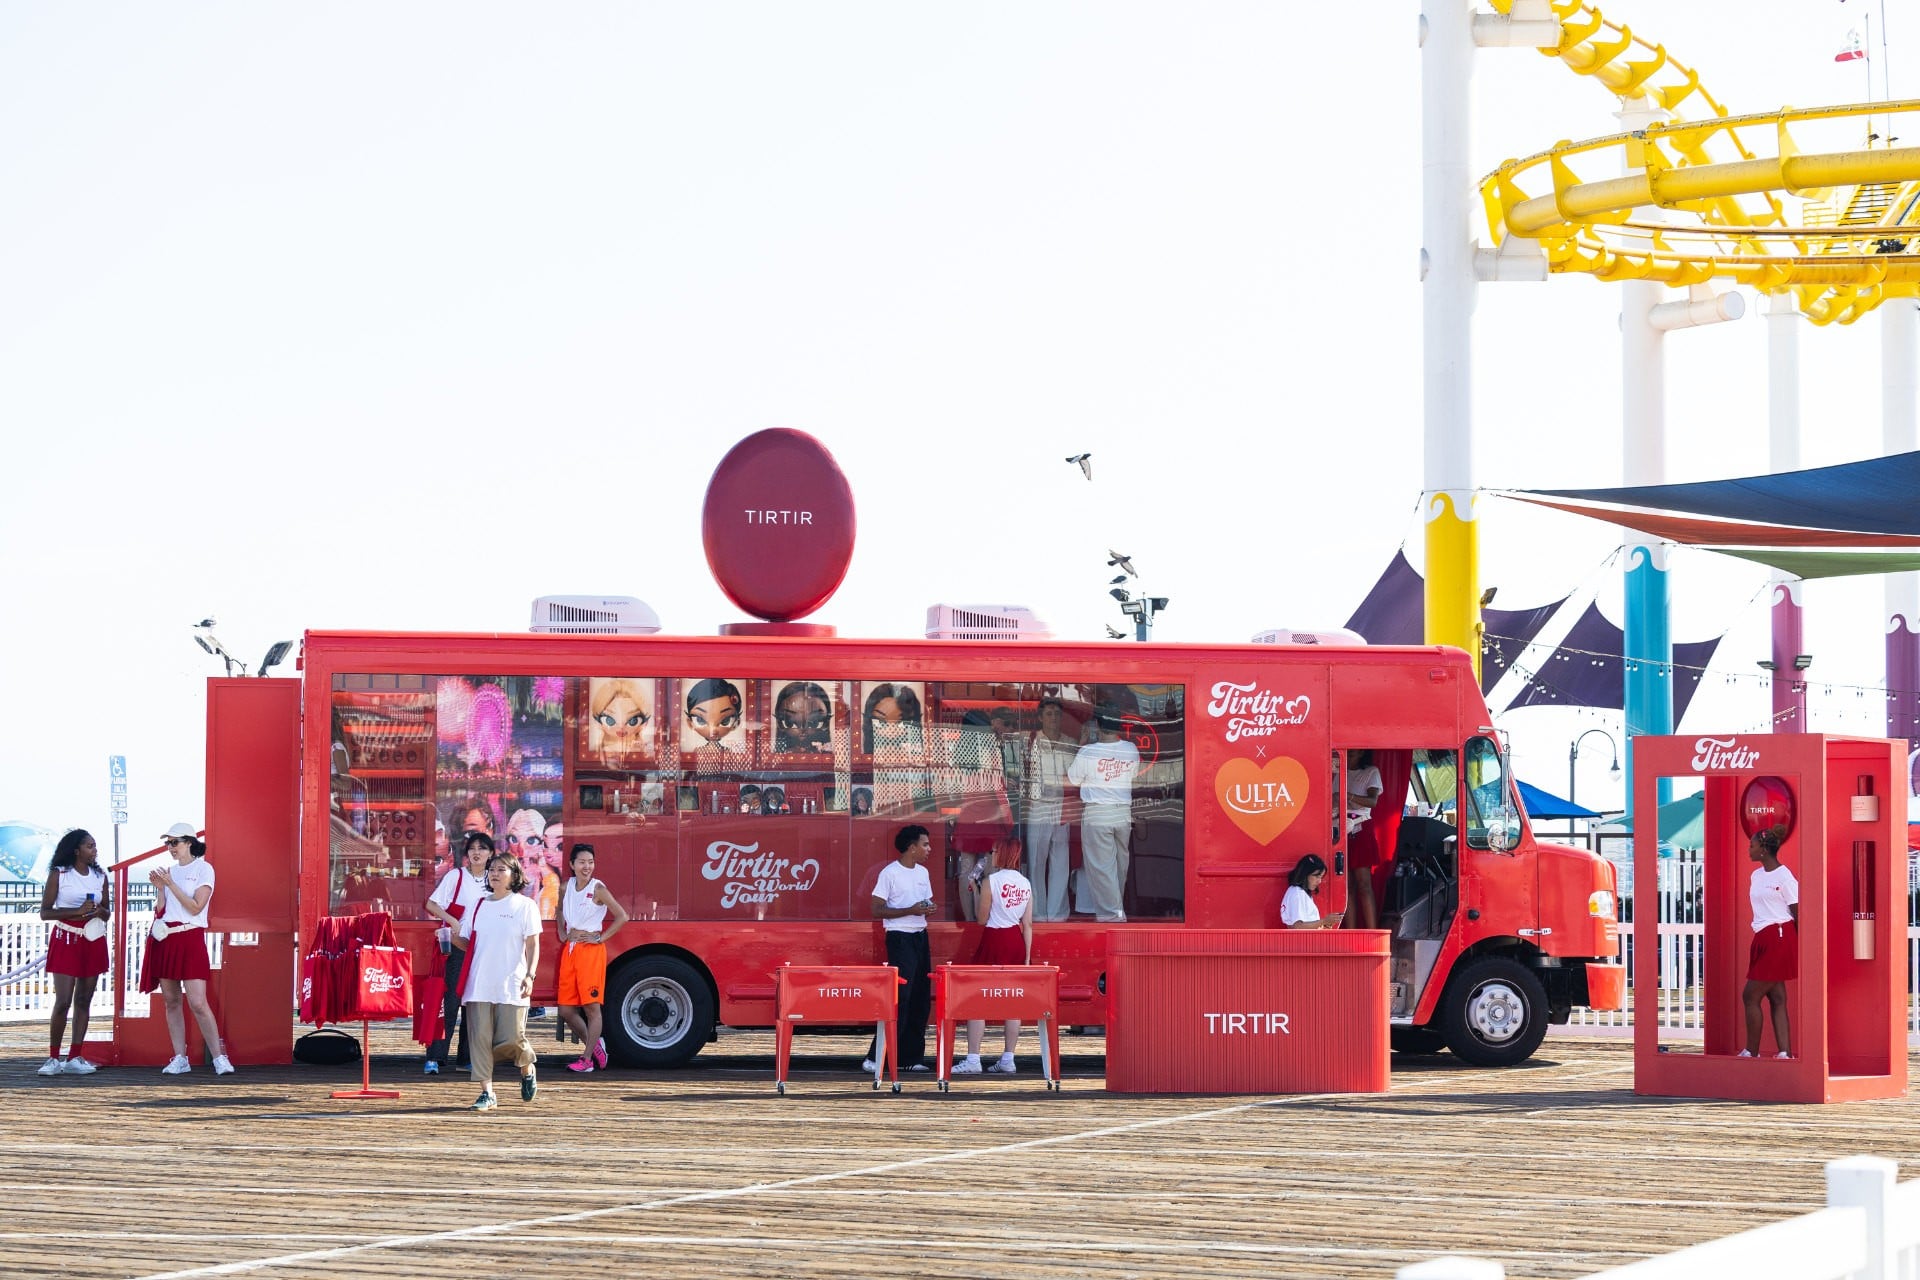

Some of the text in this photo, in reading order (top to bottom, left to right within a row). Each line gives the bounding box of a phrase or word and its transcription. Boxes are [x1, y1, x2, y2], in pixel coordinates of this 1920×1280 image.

[744, 509, 813, 525] TIRTIR
[1207, 680, 1284, 718] Tirtir
[1254, 713, 1303, 727] World
[1225, 717, 1277, 743] Tour
[1691, 737, 1761, 772] Tirtir
[1235, 782, 1292, 804] ULTA
[1252, 801, 1295, 809] BEAUTY
[701, 840, 789, 880] Tirtir
[754, 878, 810, 892] World
[720, 881, 780, 909] Tour
[1853, 912, 1875, 920] RTIR
[817, 987, 863, 999] TIRTIR
[981, 987, 1025, 998] TIRTIR
[1203, 1012, 1291, 1035] TIRTIR
